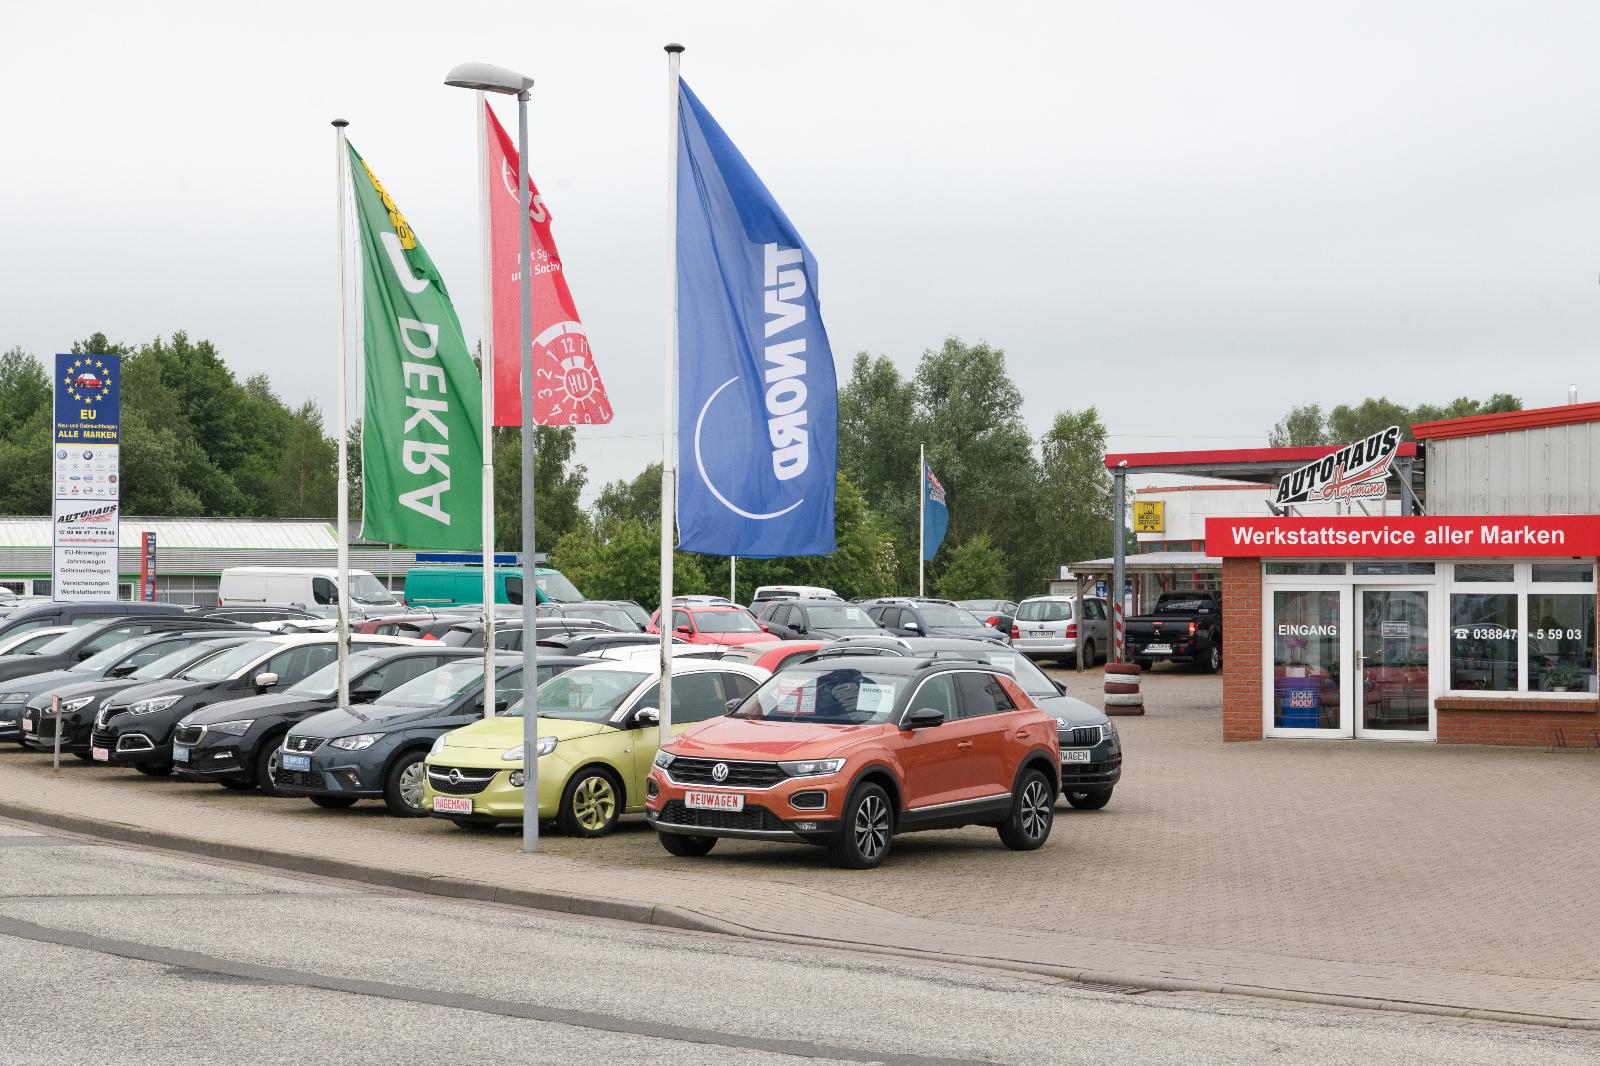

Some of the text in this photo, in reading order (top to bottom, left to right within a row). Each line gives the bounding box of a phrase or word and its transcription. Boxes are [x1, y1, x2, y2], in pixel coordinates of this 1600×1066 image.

[534, 262, 561, 275] Sachv
[561, 337, 576, 353] 12
[536, 368, 553, 380] 2
[538, 388, 553, 400] 3
[80, 409, 97, 420] EU
[58, 430, 117, 439] ALLE MARKEN
[1275, 427, 1398, 503] AUTOHAUS
[57, 504, 117, 523] AUTOHAUS
[1231, 525, 1565, 545] Werkstattservice aller Marken
[1278, 624, 1337, 636] EINGANG
[1473, 629, 1518, 640] 038847
[1536, 629, 1545, 640] 5
[1548, 629, 1563, 640] 59
[1566, 629, 1582, 640] 03
[1291, 690, 1312, 699] LIQUI
[1291, 699, 1313, 707] MOLY
[435, 797, 470, 811] HAGEMANN
[690, 792, 738, 808] NEUWAGEN
